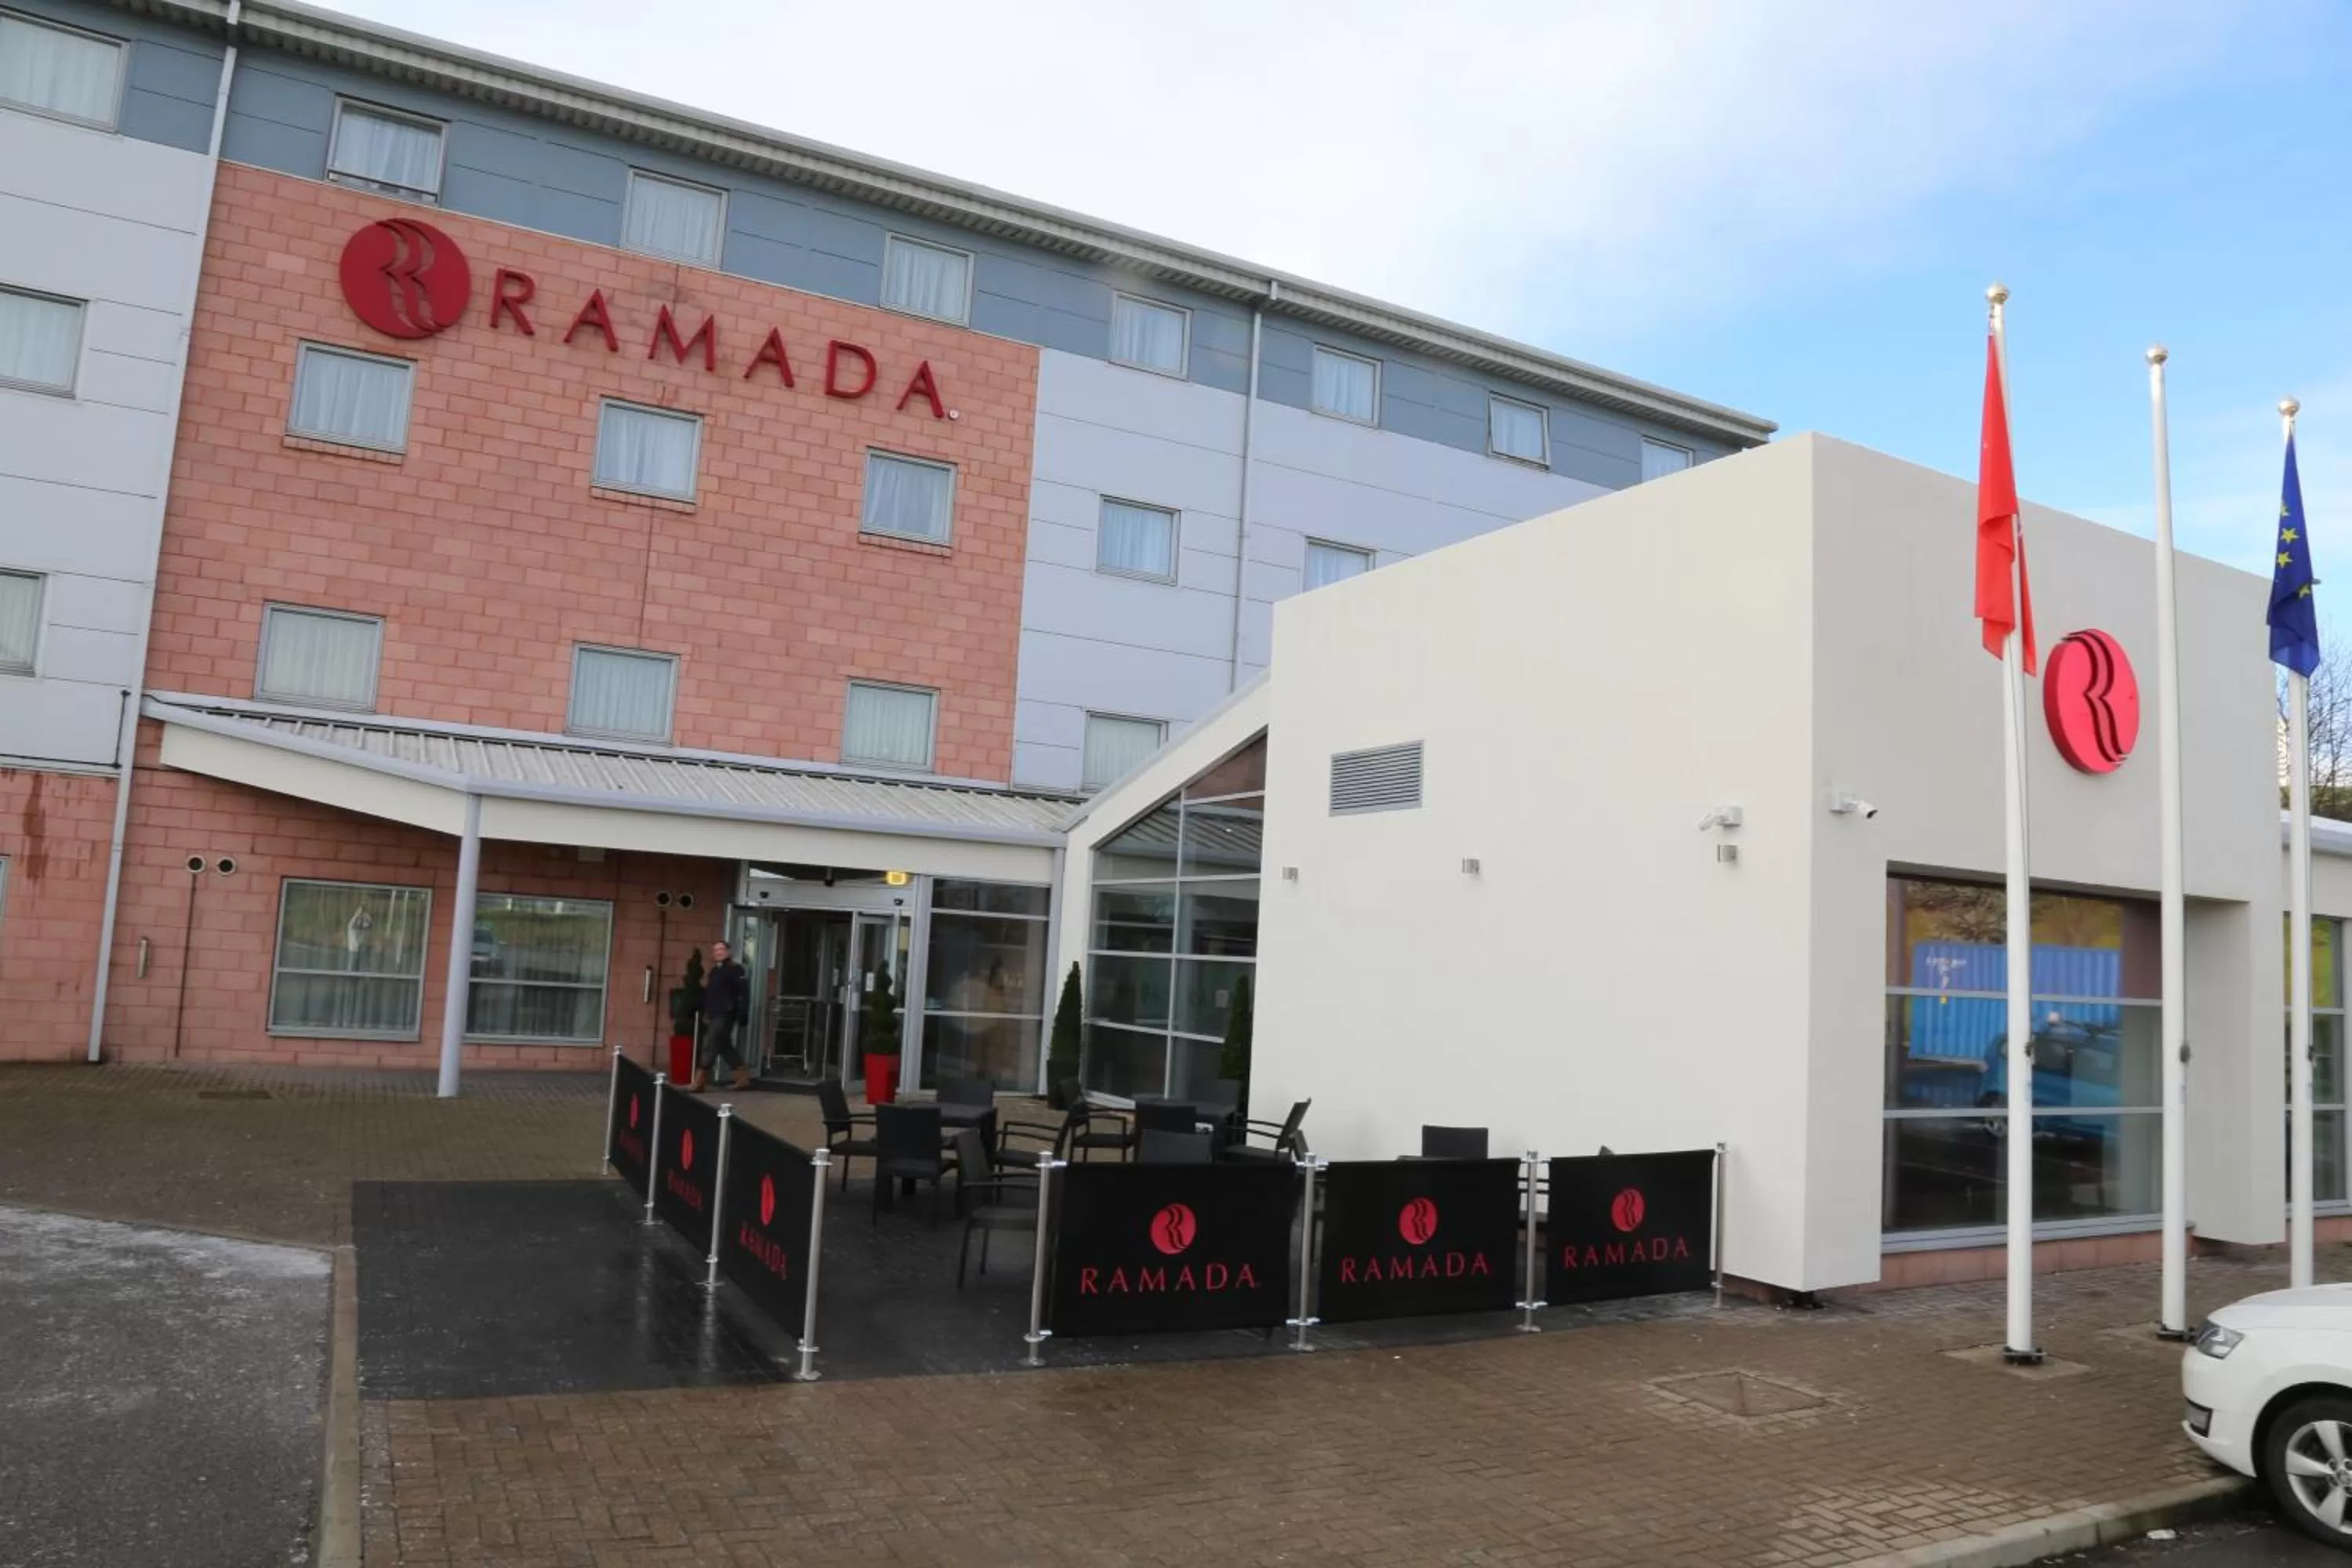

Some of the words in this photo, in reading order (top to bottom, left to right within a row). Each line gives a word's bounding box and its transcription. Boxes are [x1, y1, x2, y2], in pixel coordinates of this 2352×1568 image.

[489, 268, 944, 418] RAMADA
[1341, 1252, 1488, 1283] RAMADA
[1564, 1236, 1688, 1268] RAMADA
[1080, 1263, 1258, 1294] RAMADA
